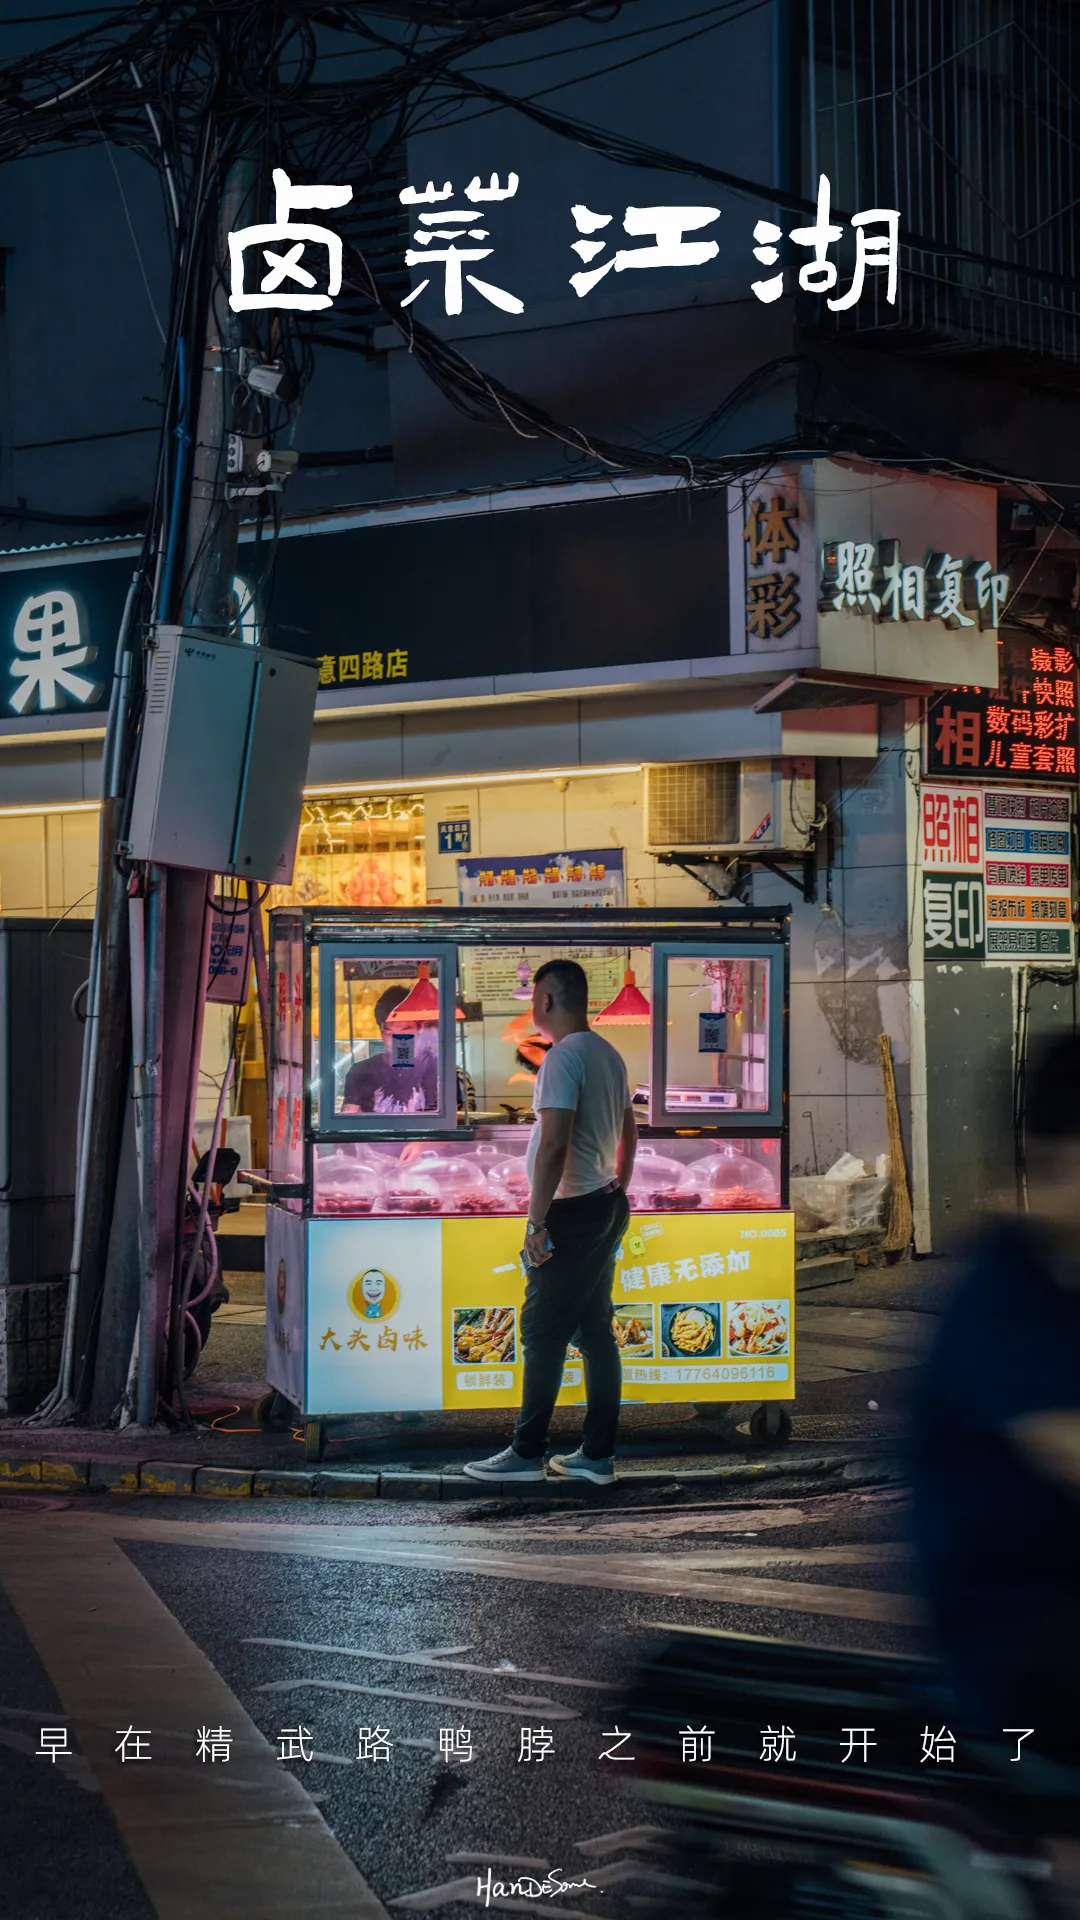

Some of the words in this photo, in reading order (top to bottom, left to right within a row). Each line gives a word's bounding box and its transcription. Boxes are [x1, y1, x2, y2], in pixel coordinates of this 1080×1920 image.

[744, 497, 801, 639] 体彩
[833, 541, 1010, 628] 照相复印
[985, 704, 1076, 742] 数码彩扩
[984, 739, 1076, 774] 儿童套照
[923, 793, 980, 864] 照相
[987, 829, 1025, 851] 修图打印
[987, 864, 1026, 886] 写真喷绘
[1030, 866, 1067, 887] 菜单传单
[923, 879, 983, 949] 复印
[1040, 931, 1059, 952] 名片
[620, 1248, 750, 1292] 健康无添加
[319, 1325, 429, 1353] 大头卤味
[464, 1373, 506, 1387] 锁鲜装
